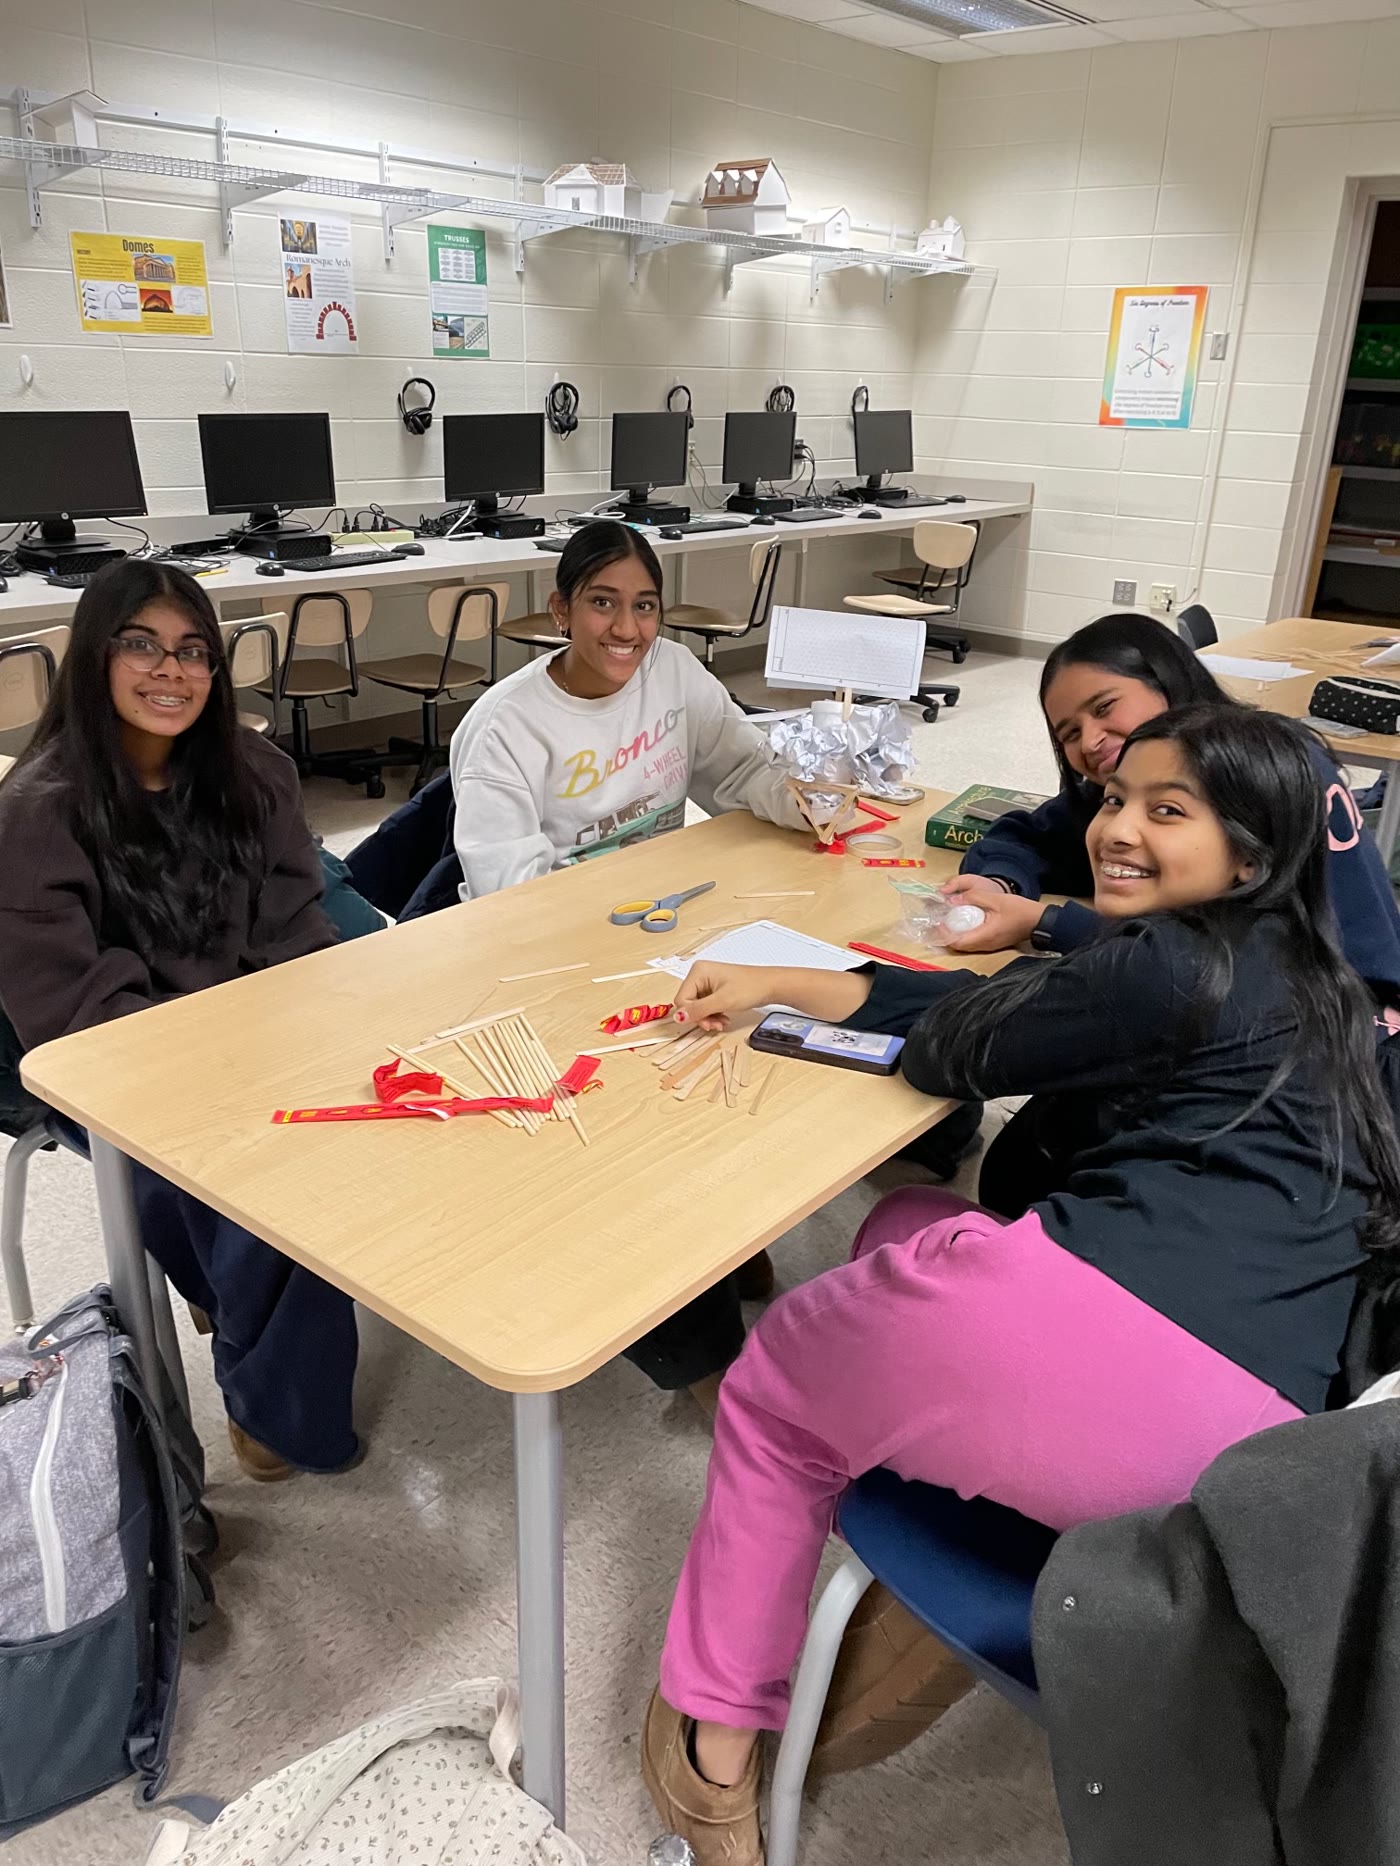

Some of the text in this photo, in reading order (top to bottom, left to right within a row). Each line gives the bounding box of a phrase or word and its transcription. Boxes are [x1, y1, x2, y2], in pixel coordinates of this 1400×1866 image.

[122, 239, 155, 254] Domes
[444, 235, 470, 243] TRUSSES
[286, 254, 351, 268] Romanesque Arch
[555, 707, 685, 799] Bronco
[643, 746, 687, 780] 4-WHEEL
